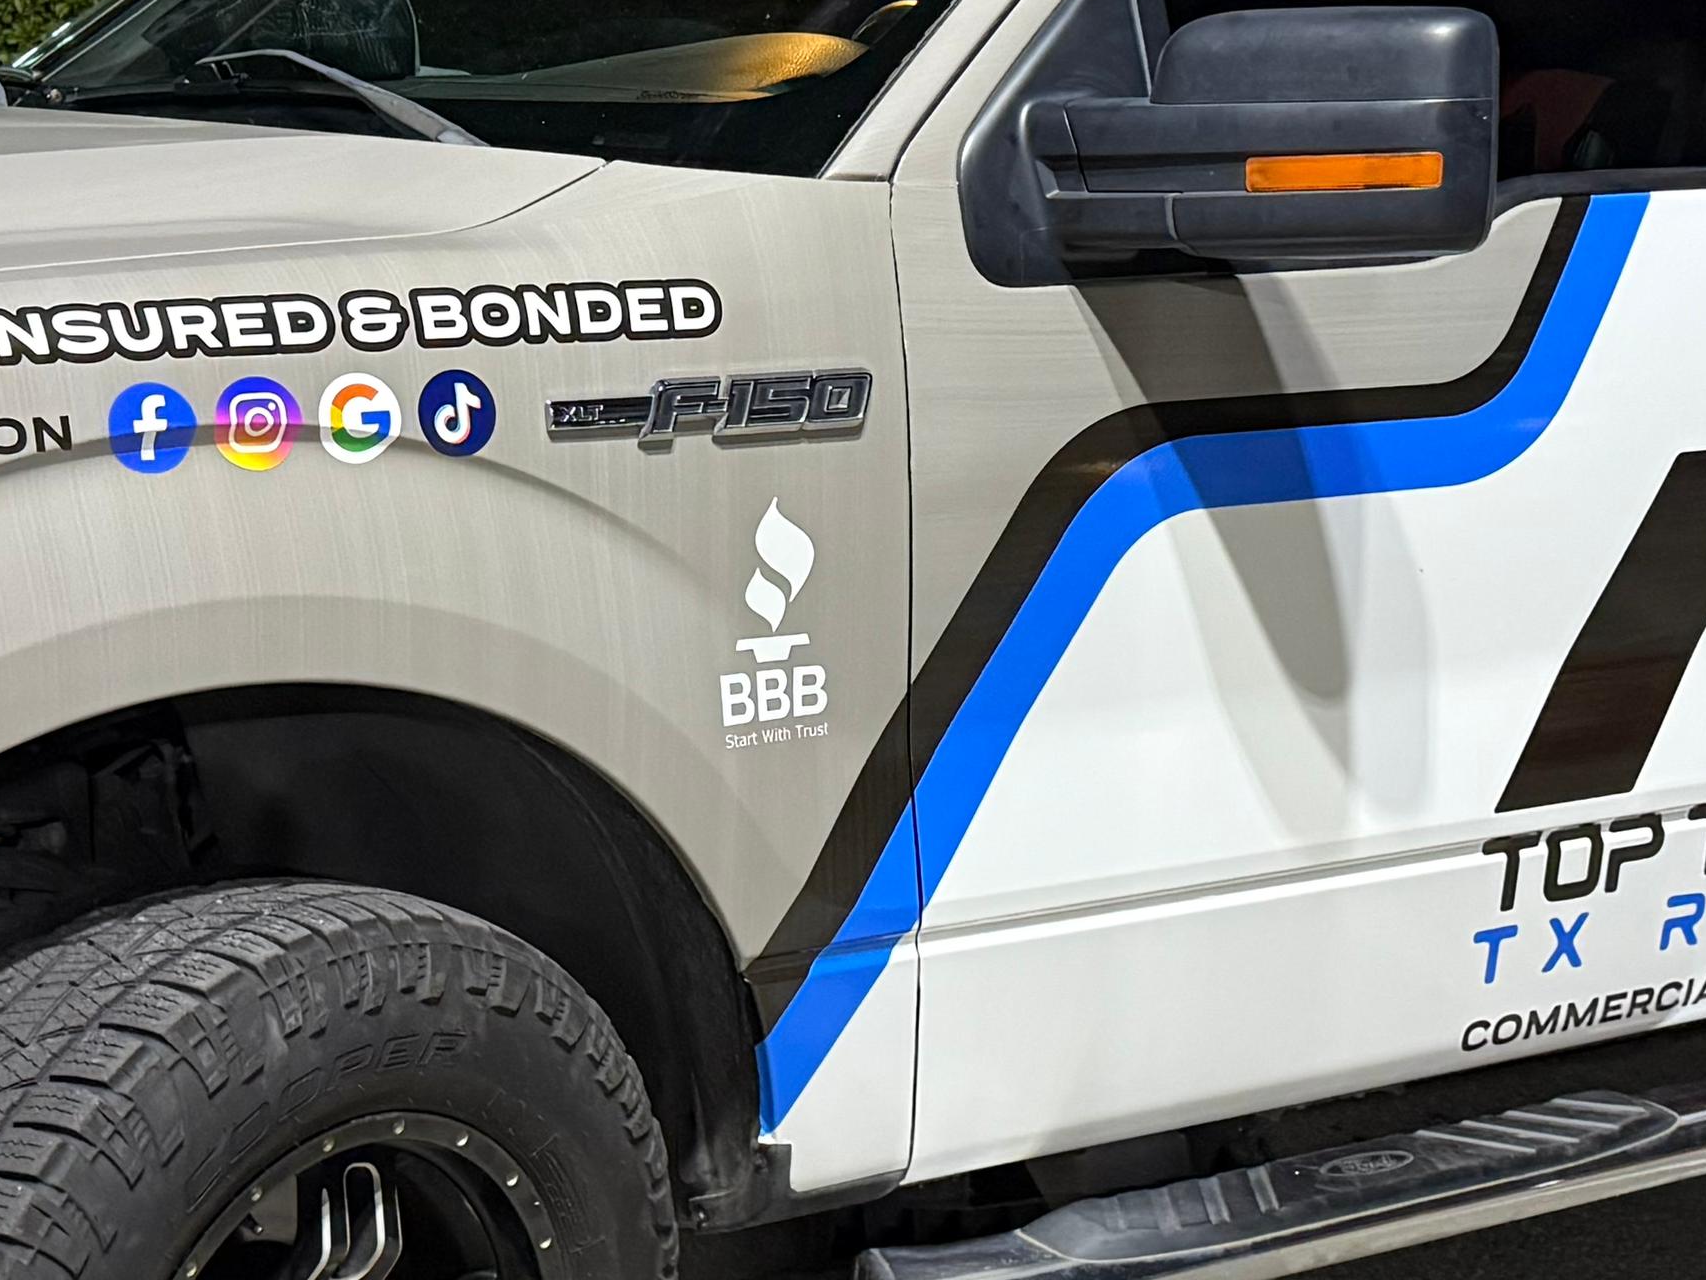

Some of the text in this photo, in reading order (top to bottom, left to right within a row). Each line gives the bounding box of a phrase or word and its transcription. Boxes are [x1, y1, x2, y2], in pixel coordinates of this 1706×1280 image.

[340, 290, 407, 350] &
[410, 280, 720, 348] BONDED
[559, 368, 873, 440] XLT F-150
[720, 665, 828, 727] BBB
[725, 722, 828, 749] Start With Trust
[1483, 813, 1665, 911] TOP
